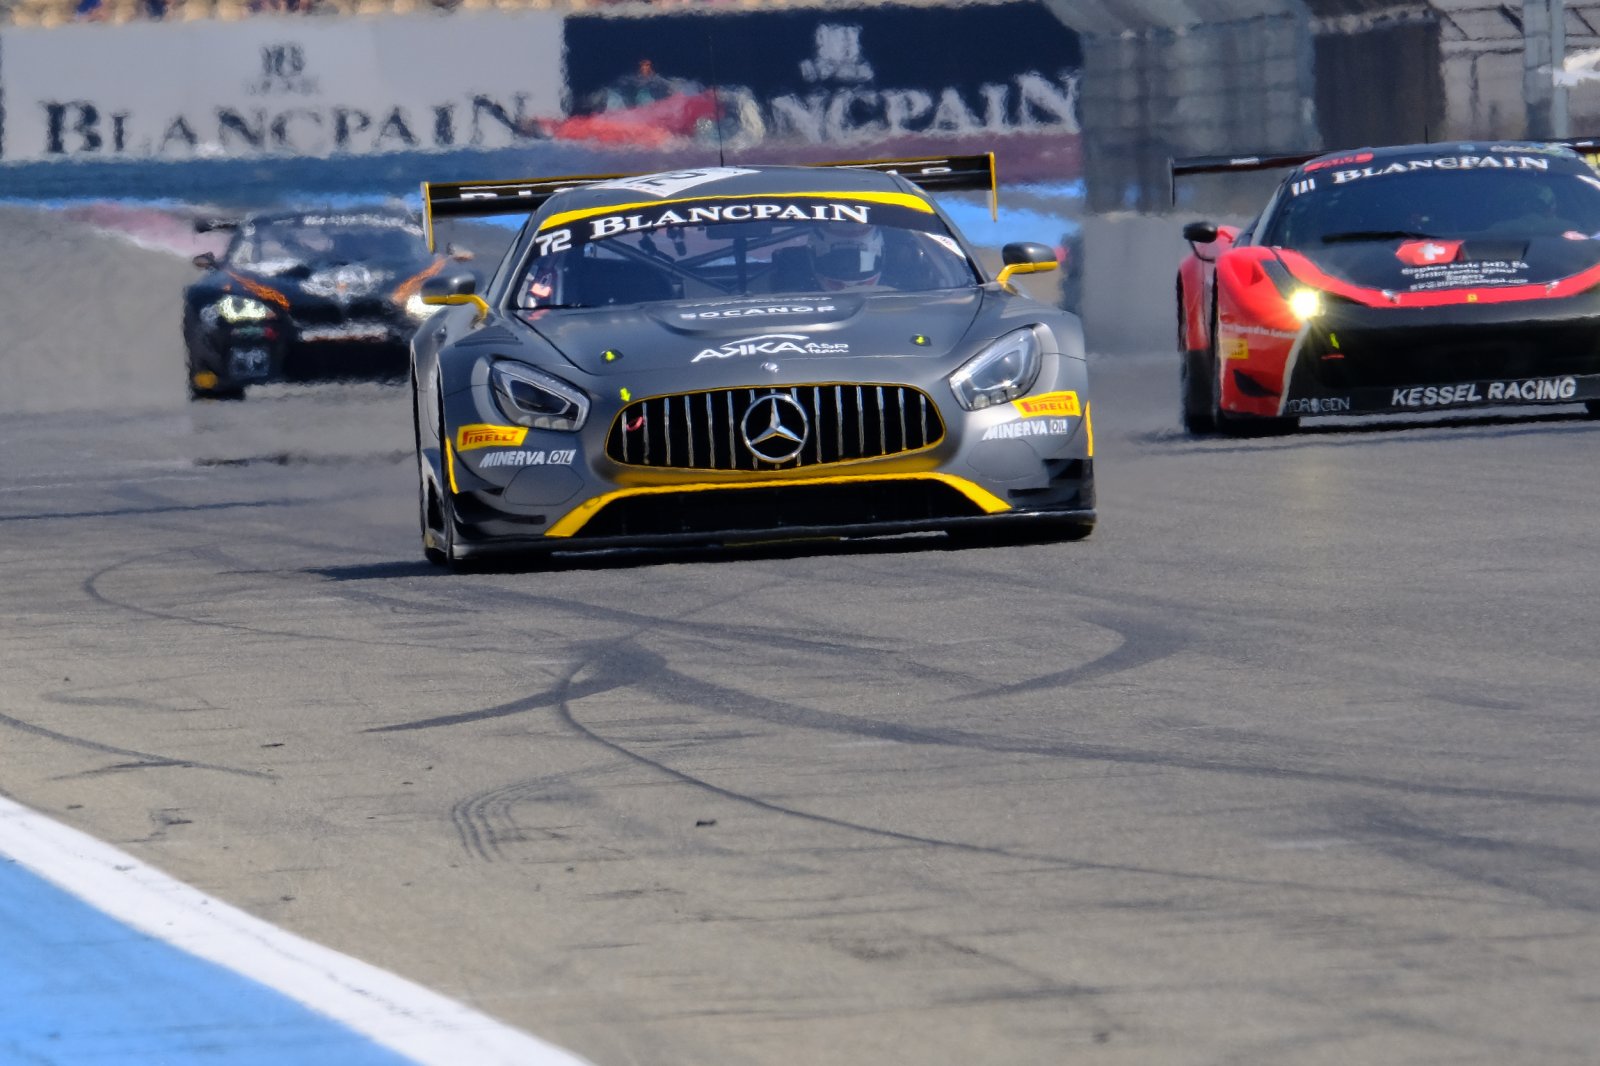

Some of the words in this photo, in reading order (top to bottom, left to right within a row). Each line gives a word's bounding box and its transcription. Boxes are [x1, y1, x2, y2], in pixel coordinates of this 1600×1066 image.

[43, 93, 540, 155] BLANCPAIN
[1332, 155, 1549, 184] BLANCPAIN
[589, 203, 870, 240] BLANCPAIN
[535, 229, 572, 257] 72
[1021, 395, 1074, 413] PIRELLI
[1391, 383, 1482, 406] KESSEL
[1487, 376, 1577, 400] RACING
[462, 428, 519, 446] PIRELLI
[982, 420, 1048, 441] MINERVA
[1050, 419, 1067, 434] OIL
[479, 451, 545, 468] MINERVA
[549, 450, 575, 464] OIL
